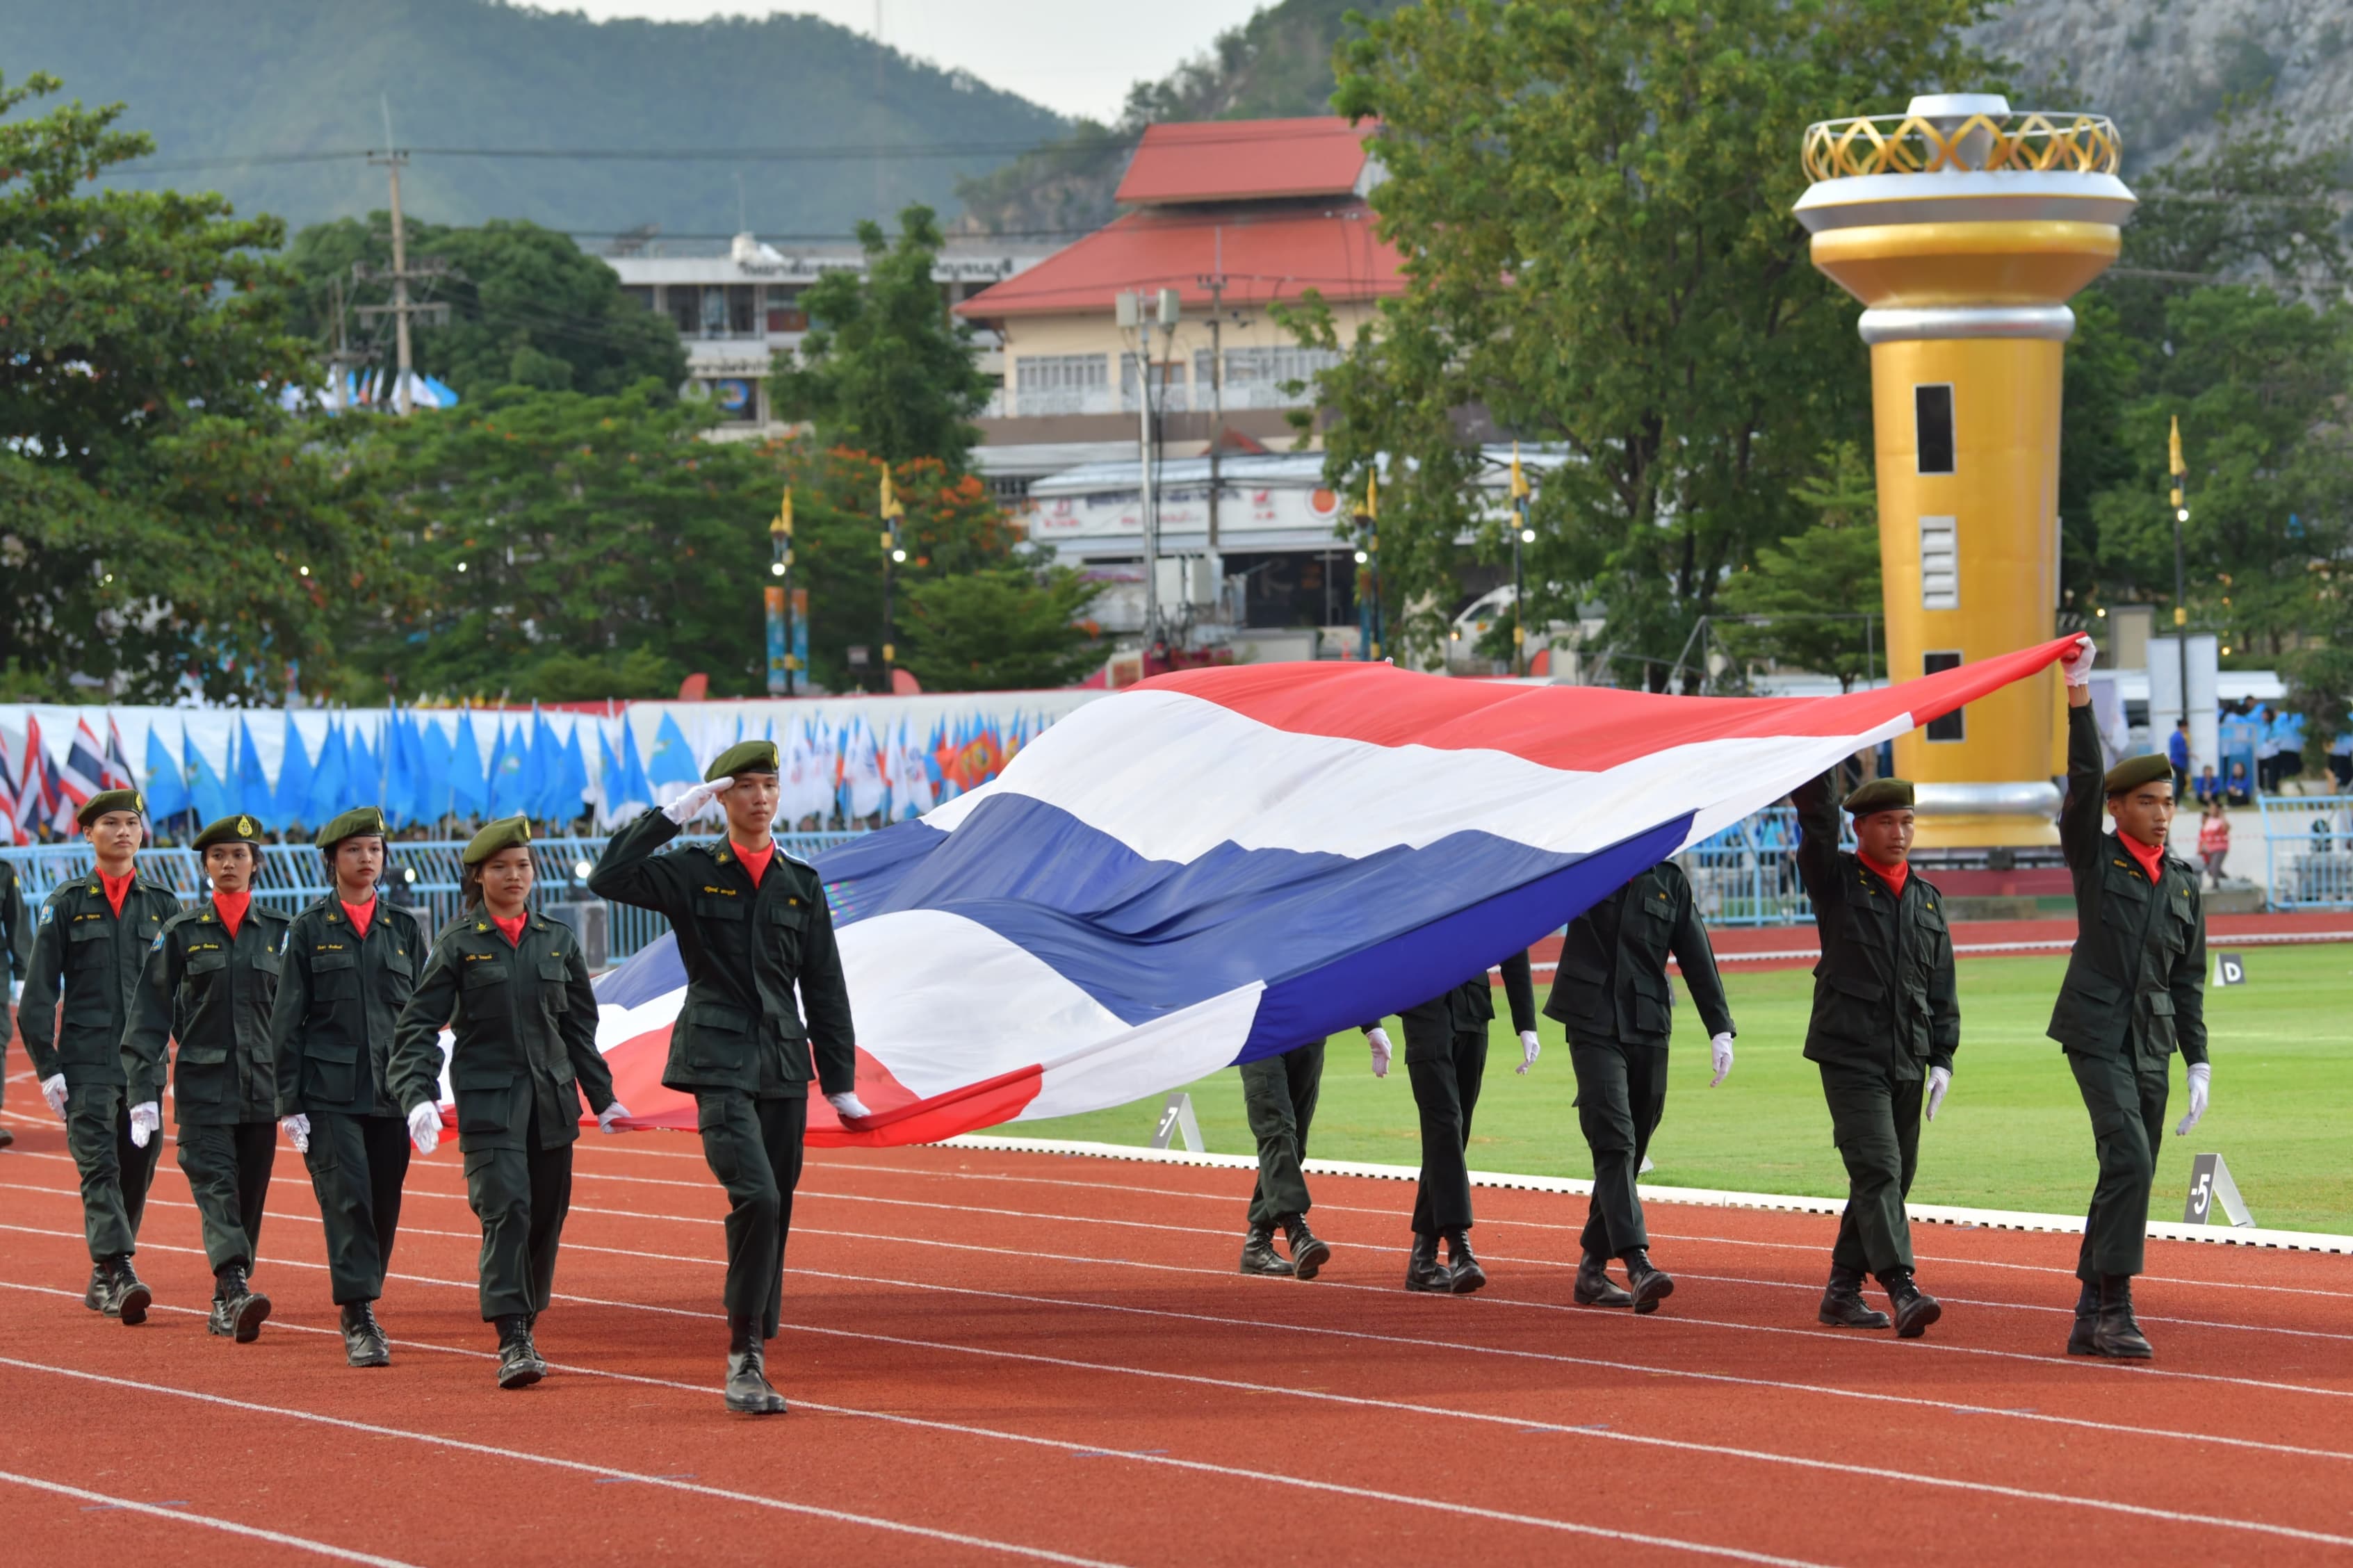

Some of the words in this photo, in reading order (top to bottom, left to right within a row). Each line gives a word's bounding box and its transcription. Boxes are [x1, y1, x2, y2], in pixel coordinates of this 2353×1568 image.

[2224, 962, 2242, 981] D
[1159, 1106, 1179, 1137] -7
[2191, 1173, 2210, 1215] -5
